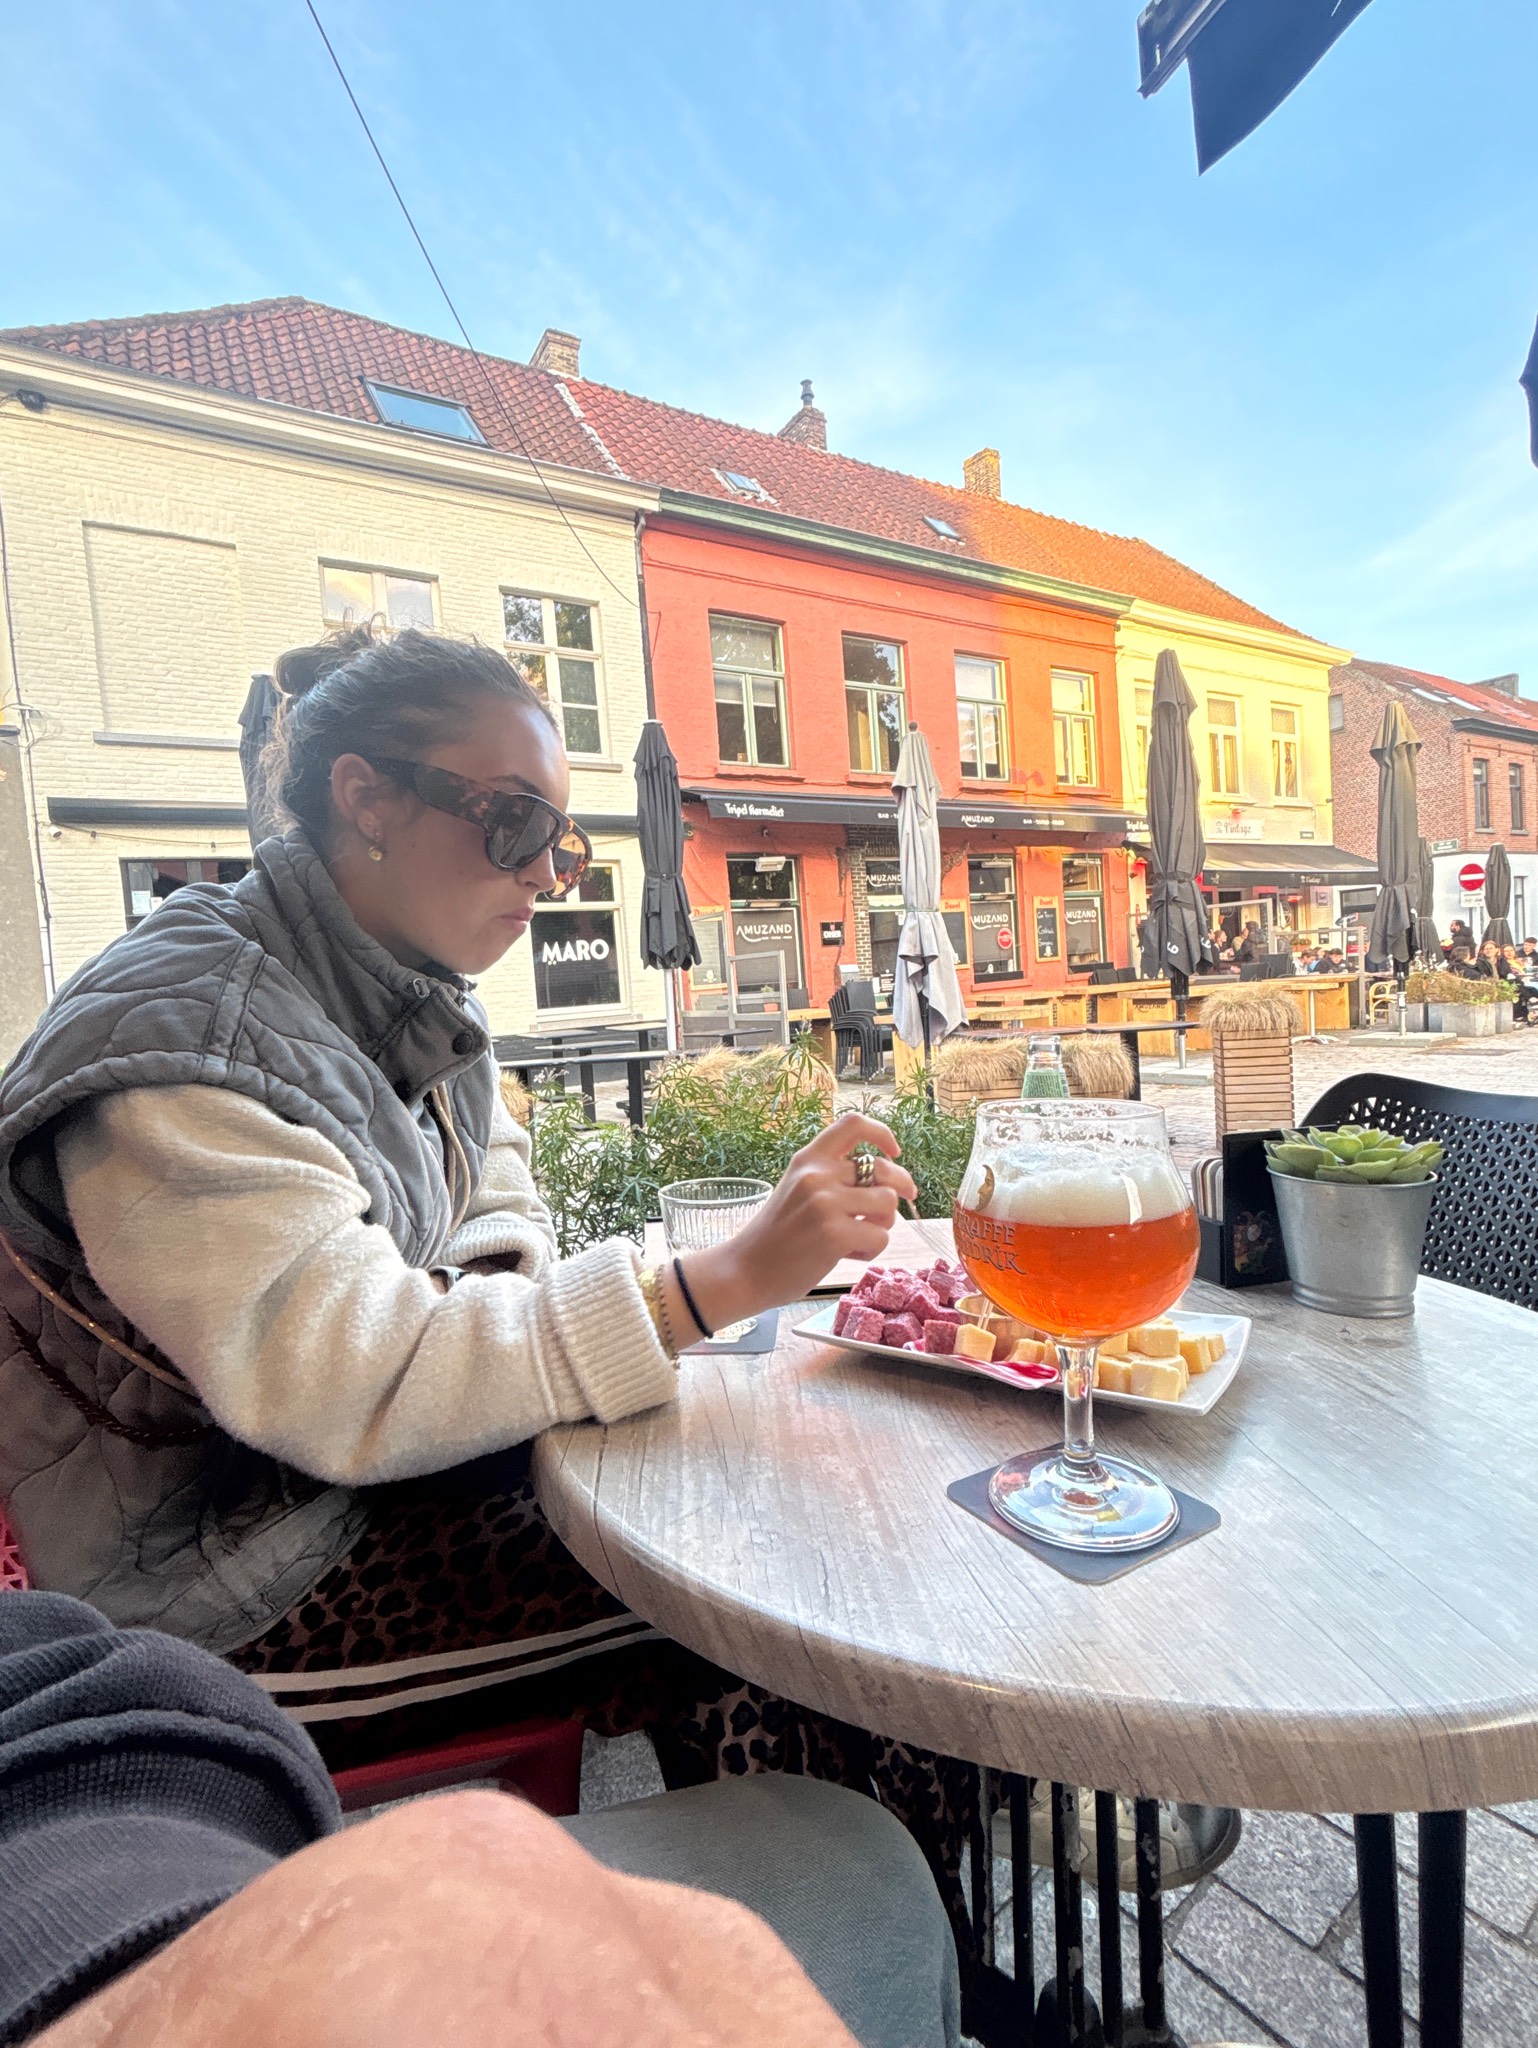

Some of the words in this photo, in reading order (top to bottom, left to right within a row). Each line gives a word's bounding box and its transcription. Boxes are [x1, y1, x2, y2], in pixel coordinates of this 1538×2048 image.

[724, 803, 747, 817] Tripel
[961, 815, 995, 826] AMUZAND
[736, 924, 793, 940] AMUZAND
[542, 939, 610, 963] MARO
[956, 1209, 1016, 1246] TRAFFE
